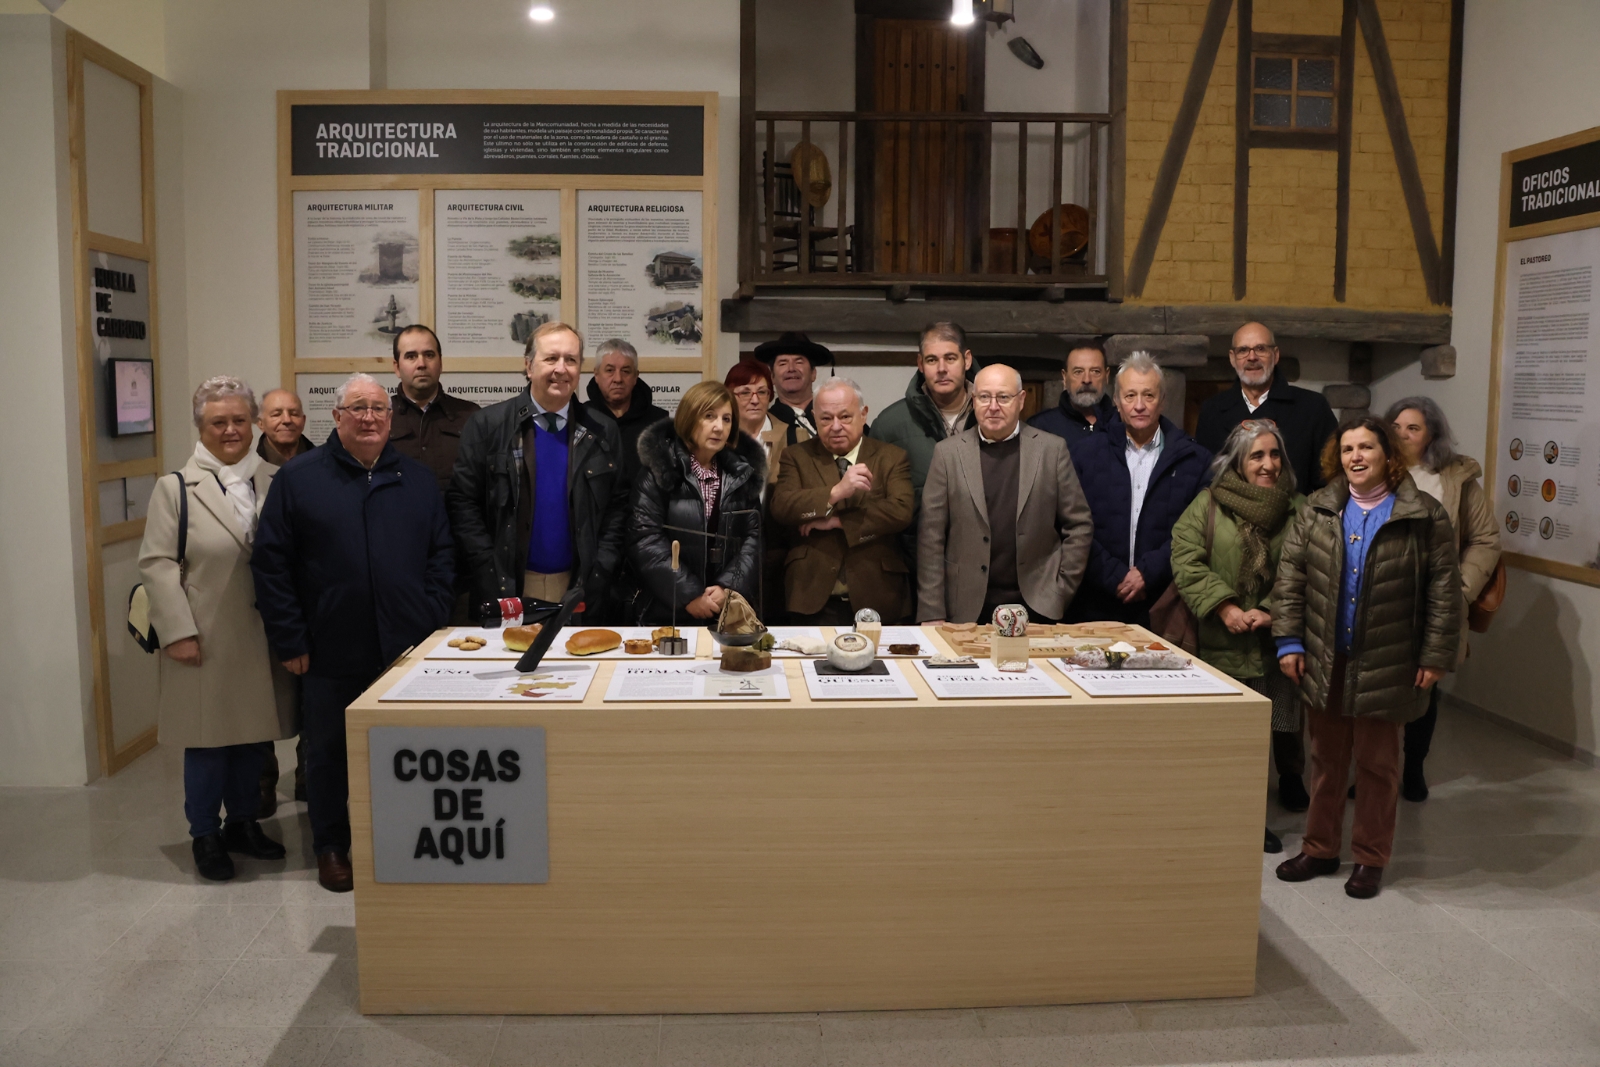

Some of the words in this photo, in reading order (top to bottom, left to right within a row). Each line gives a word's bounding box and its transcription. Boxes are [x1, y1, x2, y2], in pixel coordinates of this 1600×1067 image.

[316, 122, 457, 142] ARQUITECTURA
[316, 142, 439, 158] TRADICIONAL
[1522, 166, 1570, 192] OFICIOS
[307, 204, 363, 212] ARQUITECTURA
[447, 204, 504, 212] ARQUITECTURA
[588, 204, 644, 213] ARQUITECTURA
[95, 267, 136, 293] HUELLA
[96, 292, 112, 313] DE
[97, 317, 146, 340] CARBONO
[394, 748, 521, 782] COSAS
[433, 788, 484, 821] DE
[414, 818, 505, 865] AQUÍ
